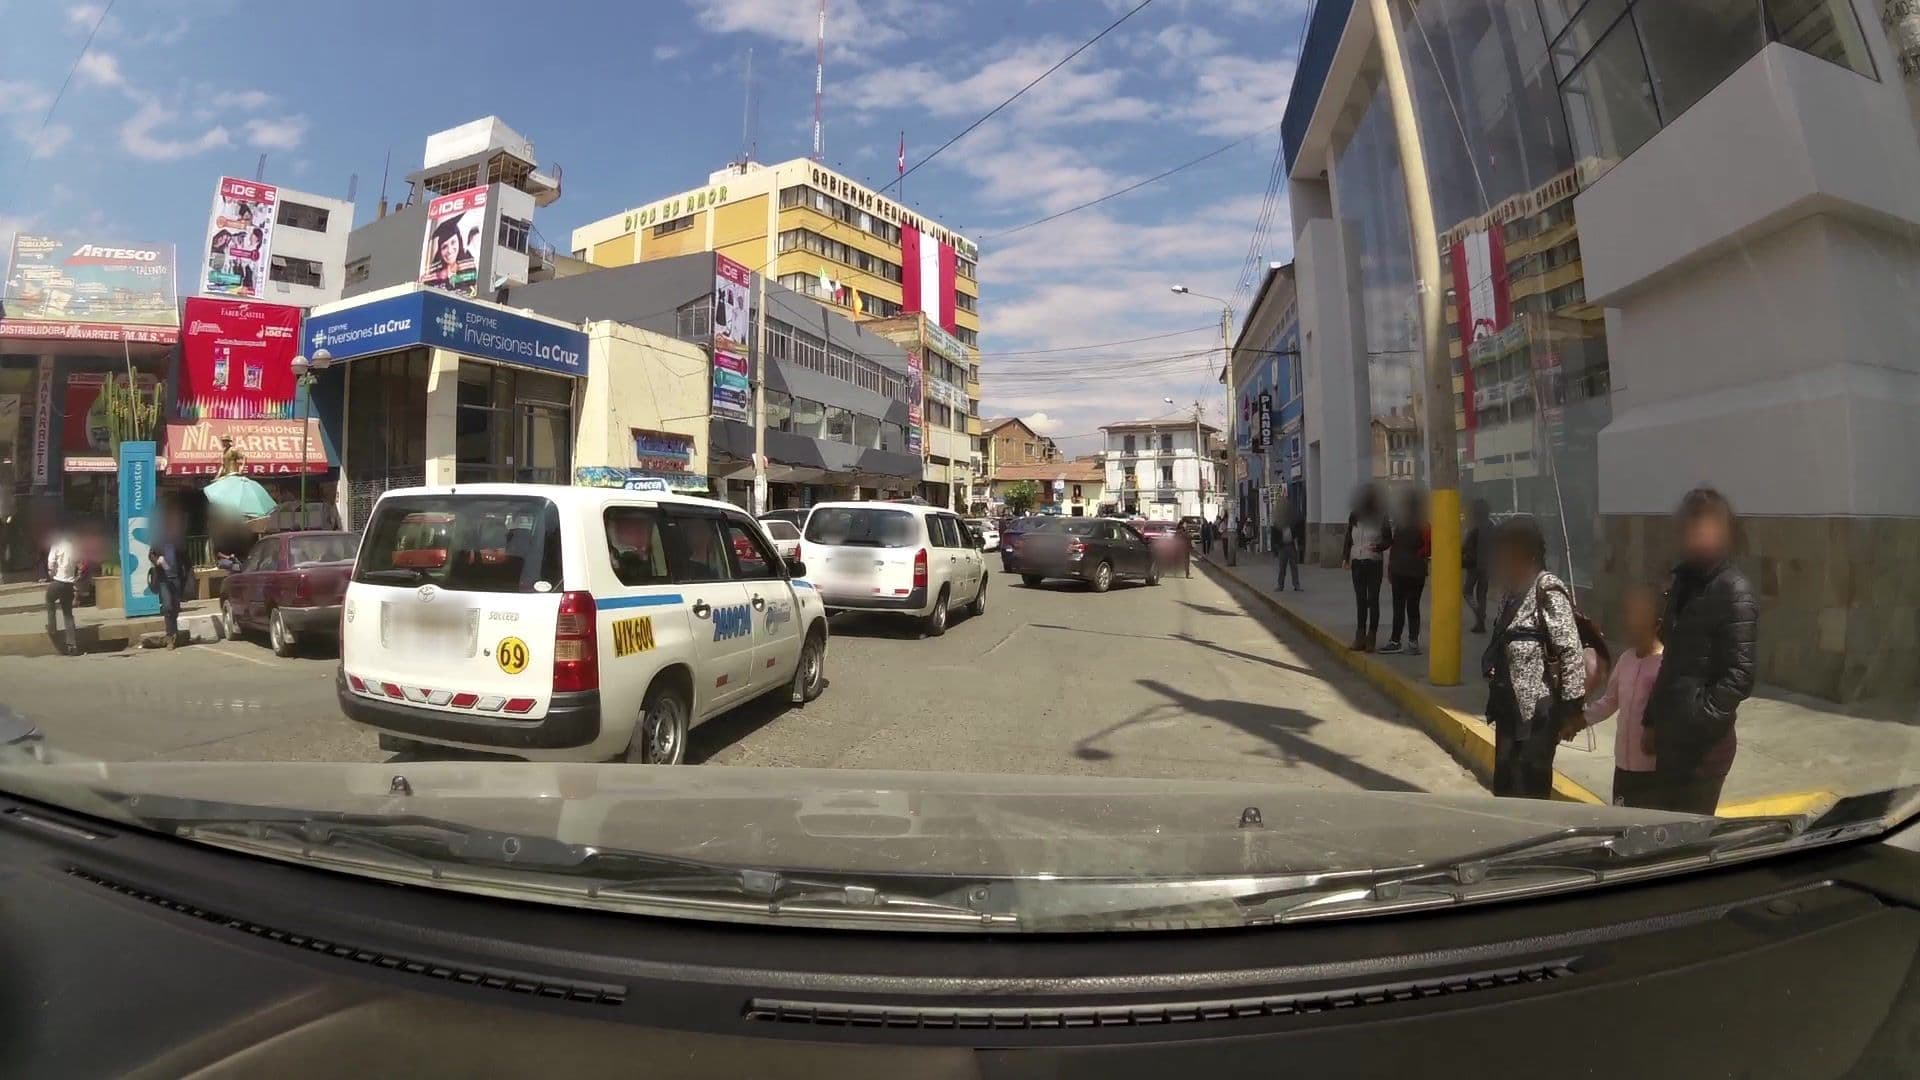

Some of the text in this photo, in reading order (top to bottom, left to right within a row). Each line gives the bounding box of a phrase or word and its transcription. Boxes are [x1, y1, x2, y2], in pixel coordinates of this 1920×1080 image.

[625, 185, 728, 232] DIOS ES AMOR
[812, 168, 873, 209] GOBIERNO
[877, 198, 926, 234] REGIONAL
[73, 244, 157, 261] ARTESCO
[0, 324, 66, 336] DISTRIBUIDORA
[327, 318, 411, 346] Inversiones La Cruz
[465, 312, 498, 330] EDPYME
[464, 324, 579, 366] Inversiones La Cruz
[227, 424, 306, 434] INVERSIONES
[1260, 395, 1272, 445] PLANOS
[181, 422, 316, 452] NAARRETE
[181, 462, 290, 474] LIBERÍA
[500, 641, 525, 669] 69
